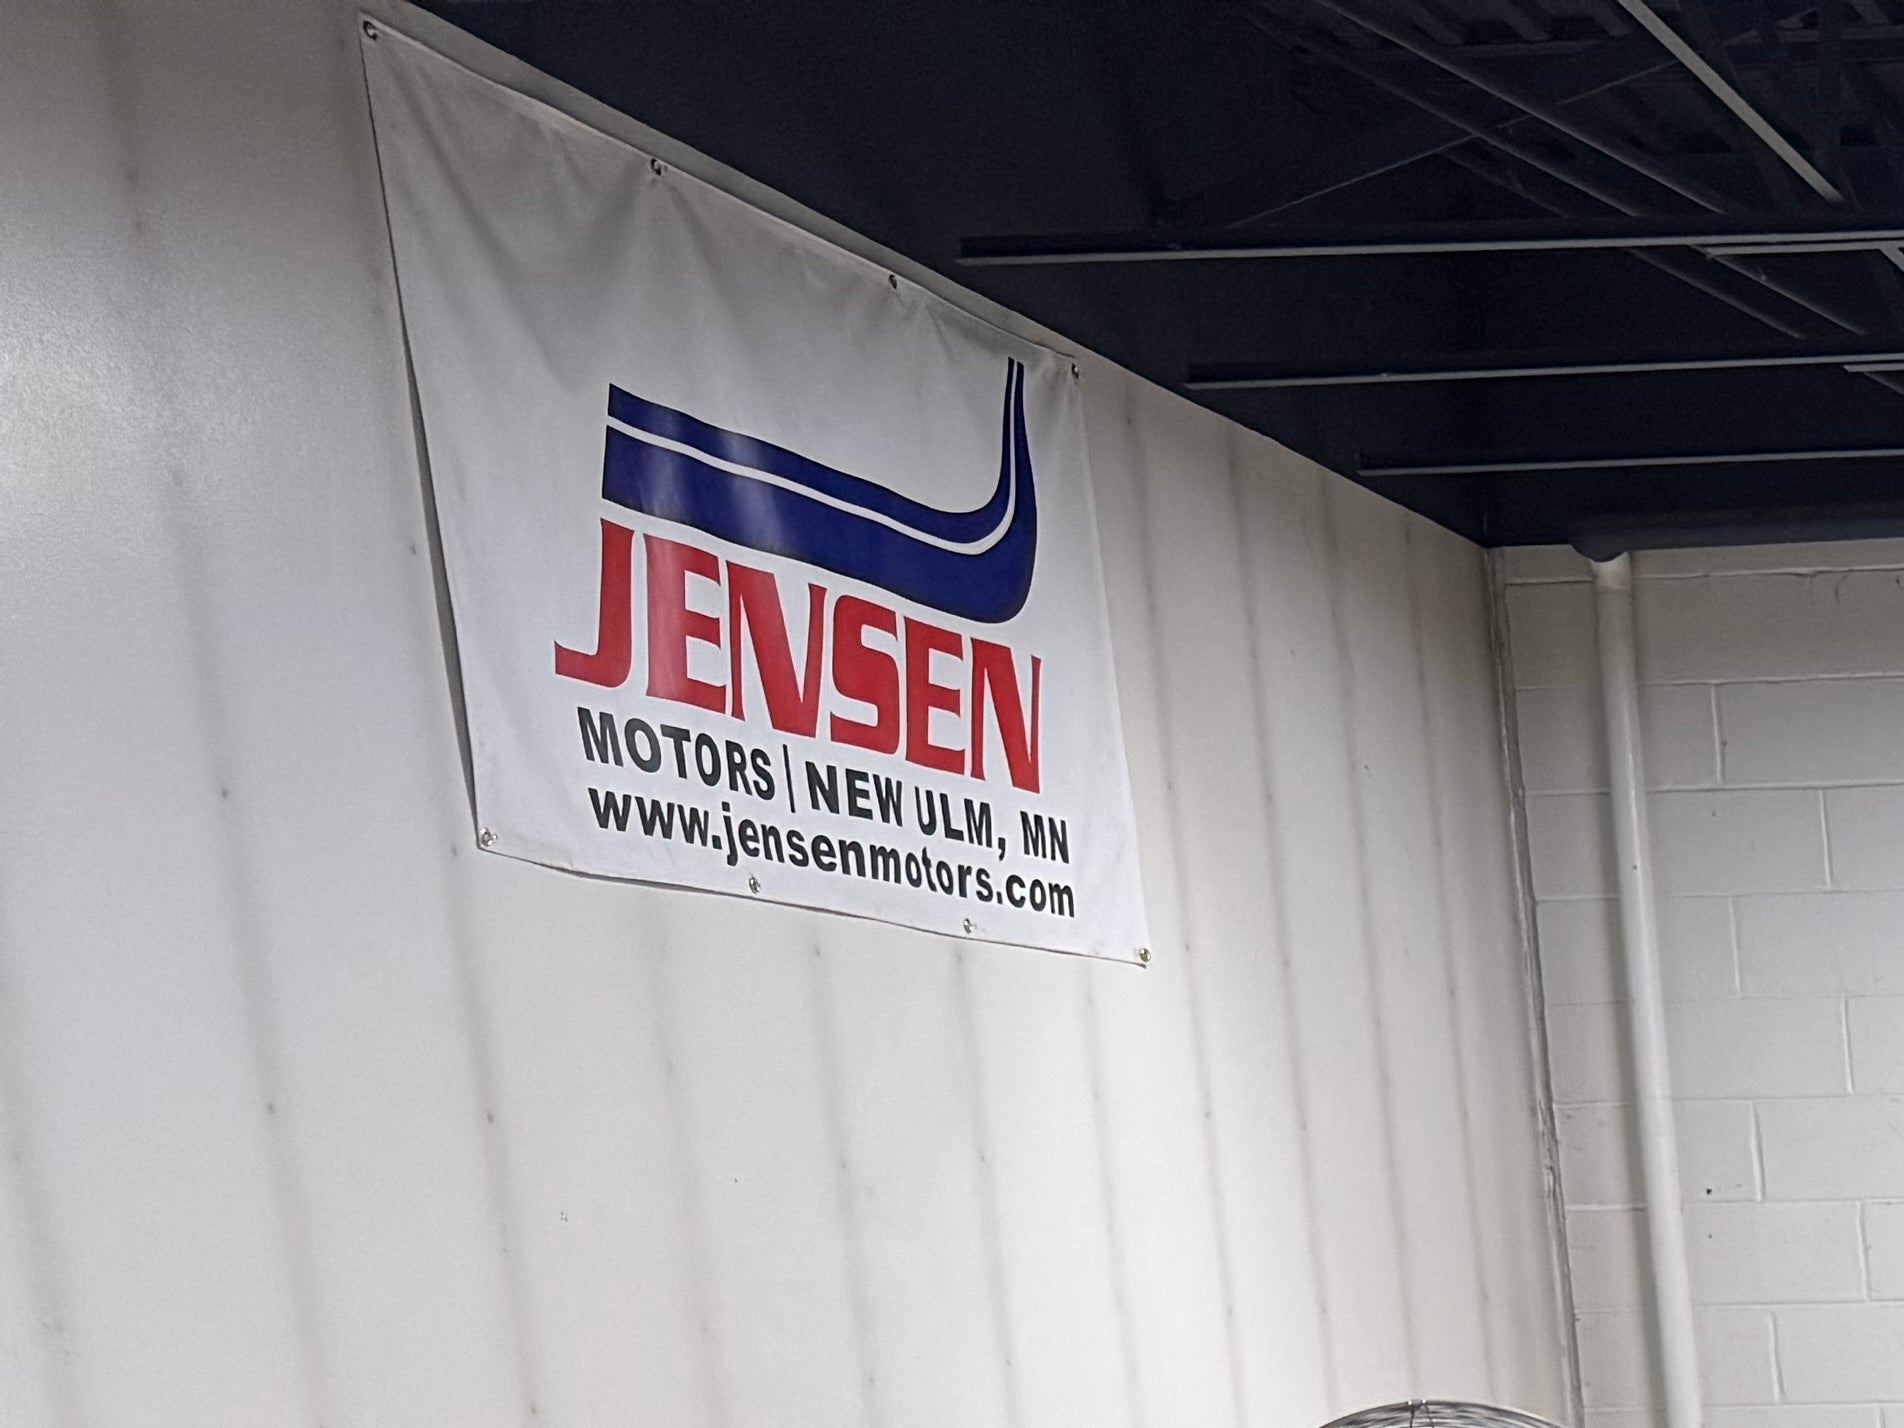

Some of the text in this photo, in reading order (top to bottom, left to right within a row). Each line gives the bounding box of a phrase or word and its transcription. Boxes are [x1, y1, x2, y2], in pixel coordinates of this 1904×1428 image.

[555, 518, 1041, 794] JENSEN
[577, 706, 776, 801] MOTORS
[804, 760, 903, 827] NEW
[914, 786, 1006, 862] ULM,
[1019, 810, 1070, 864] MN
[587, 787, 1075, 918] www.jensenmotors.com
